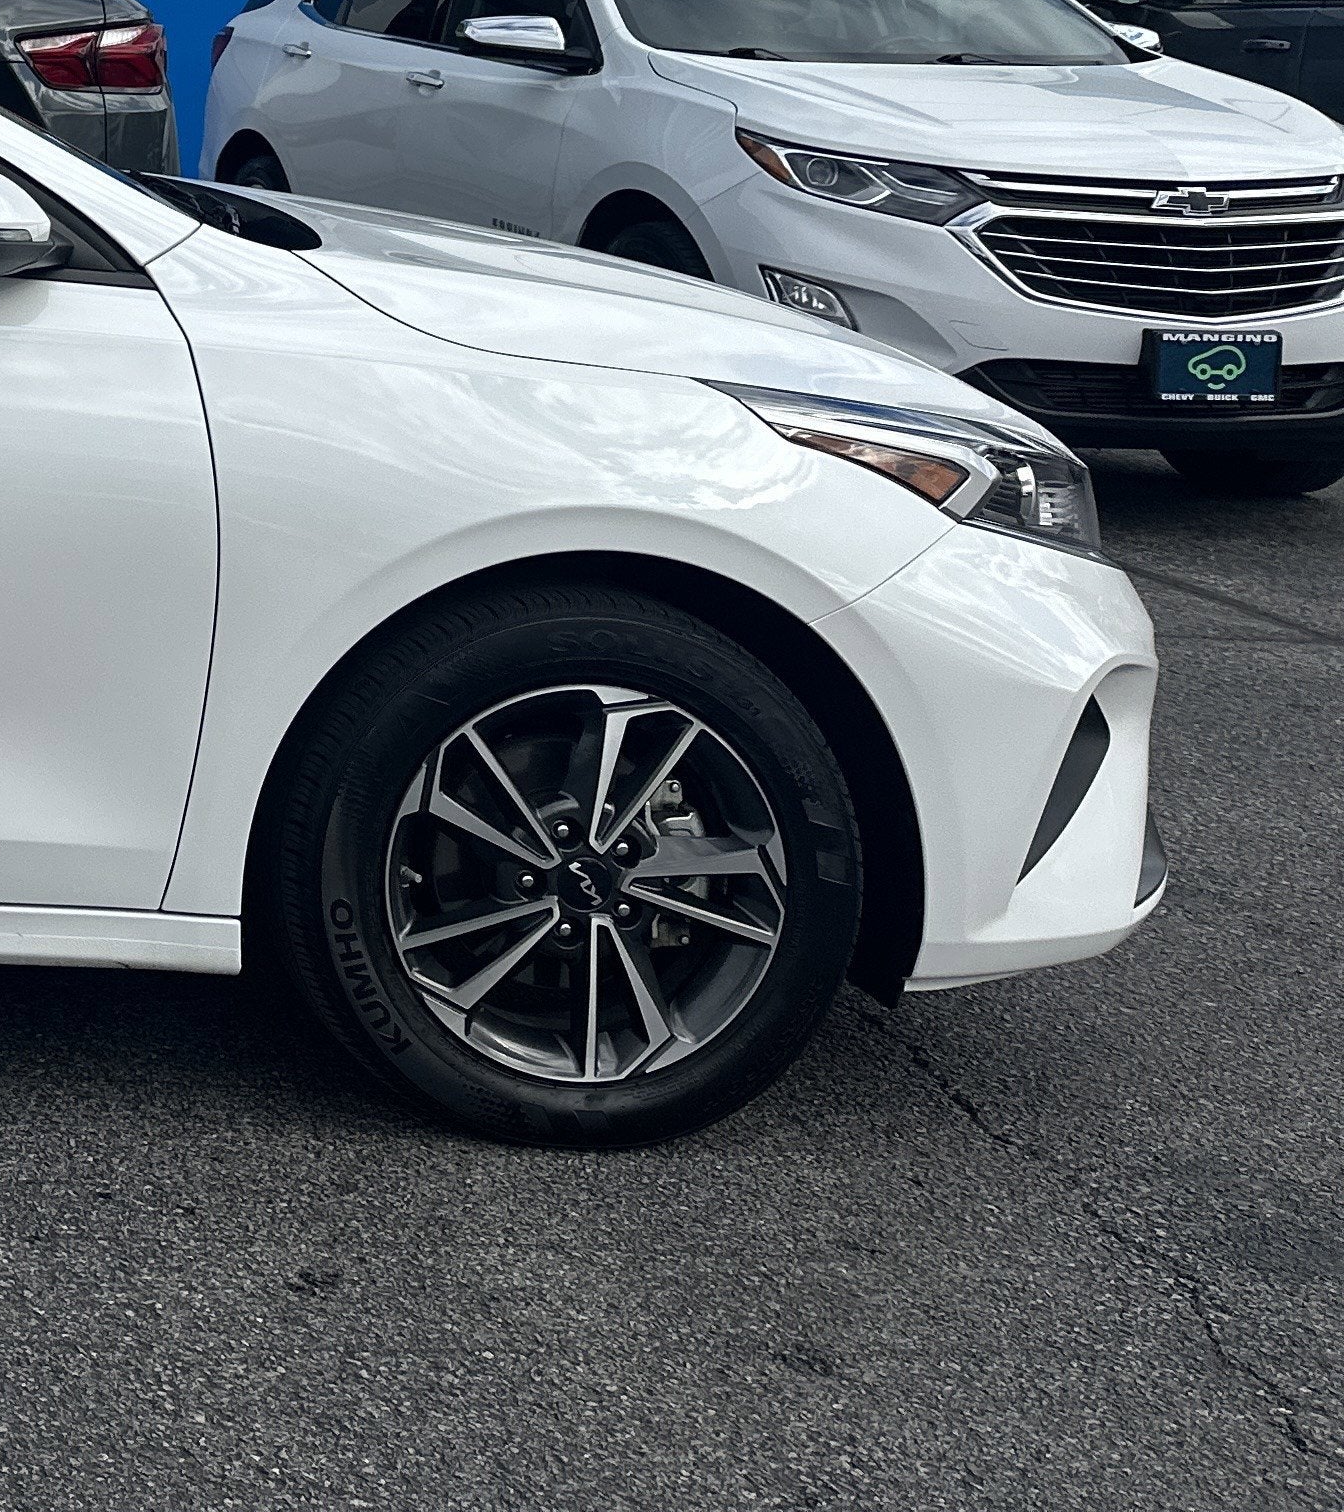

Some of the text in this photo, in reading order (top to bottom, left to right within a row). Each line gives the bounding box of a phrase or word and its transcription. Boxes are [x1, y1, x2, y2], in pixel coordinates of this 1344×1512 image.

[1162, 333, 1278, 343] MANGINO
[1161, 393, 1195, 401] CHEVY
[1250, 394, 1275, 402] GMC
[330, 898, 413, 1055] KUMHO
